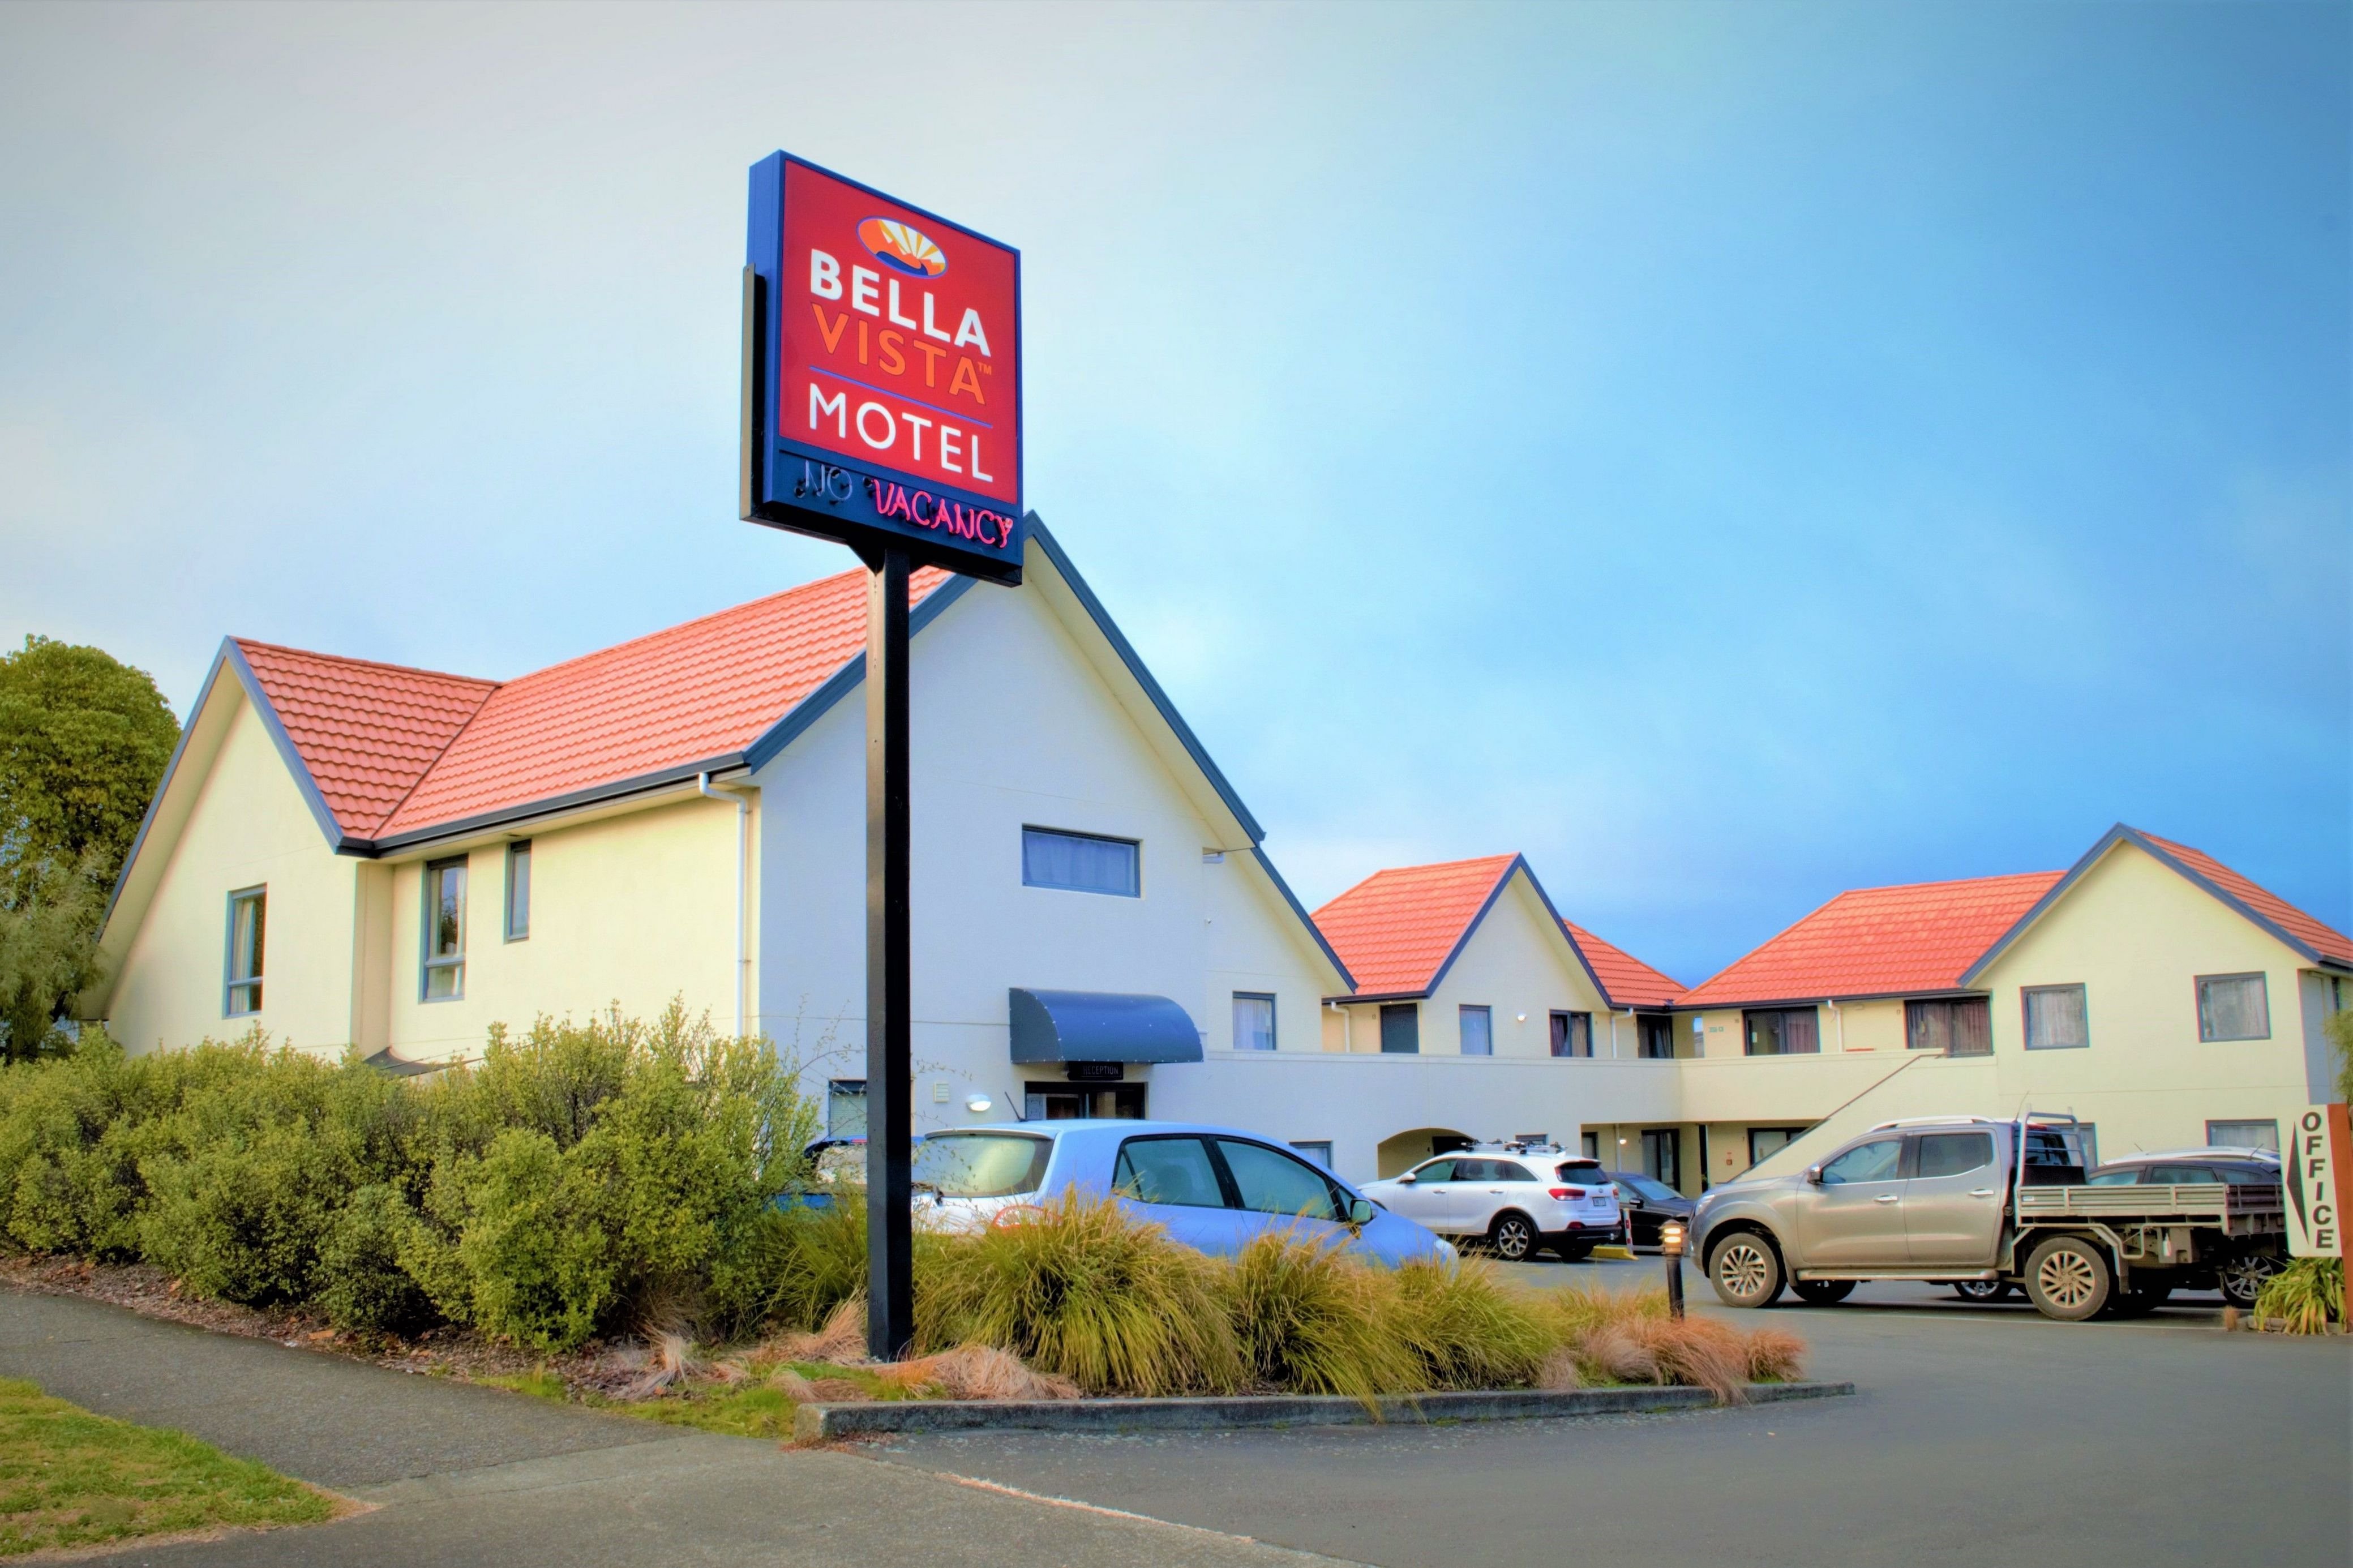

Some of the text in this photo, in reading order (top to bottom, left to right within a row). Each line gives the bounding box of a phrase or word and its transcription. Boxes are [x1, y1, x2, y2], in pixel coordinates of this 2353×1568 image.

[811, 249, 991, 357] BELLA
[811, 302, 986, 405] VISTA
[809, 383, 993, 482] MOTEL
[805, 460, 1013, 549] NO VACANCY
[1083, 1065, 1118, 1075] RECEPTION
[2301, 1112, 2334, 1248] OFFICE
